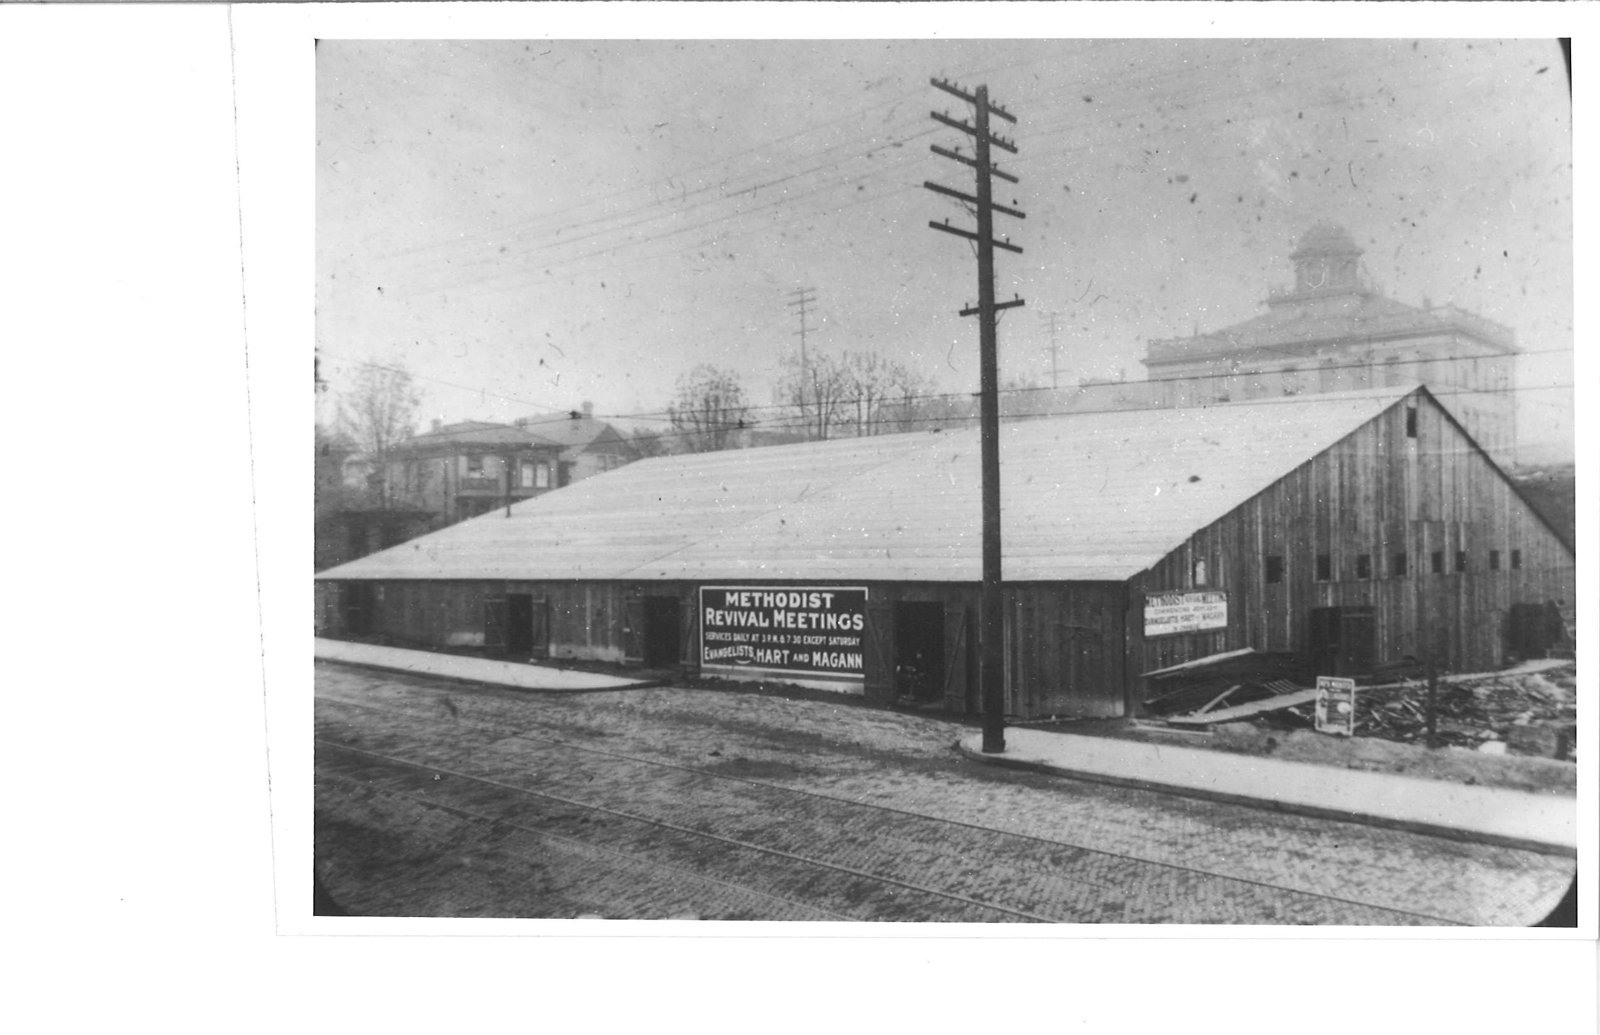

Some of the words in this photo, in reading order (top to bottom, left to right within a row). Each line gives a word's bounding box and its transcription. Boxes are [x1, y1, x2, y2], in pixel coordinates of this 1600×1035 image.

[725, 591, 835, 609] METHODIST
[705, 607, 769, 628] REVIVAL
[773, 609, 864, 631] MEETINGS
[705, 631, 732, 641] SERVICES
[733, 632, 750, 642] DAILY
[751, 633, 760, 642] AT
[803, 635, 827, 645] EXCEPT
[828, 635, 860, 646] SATURDAY
[756, 648, 790, 665] HART
[793, 653, 810, 663] AND
[812, 651, 863, 669] MAGANN
